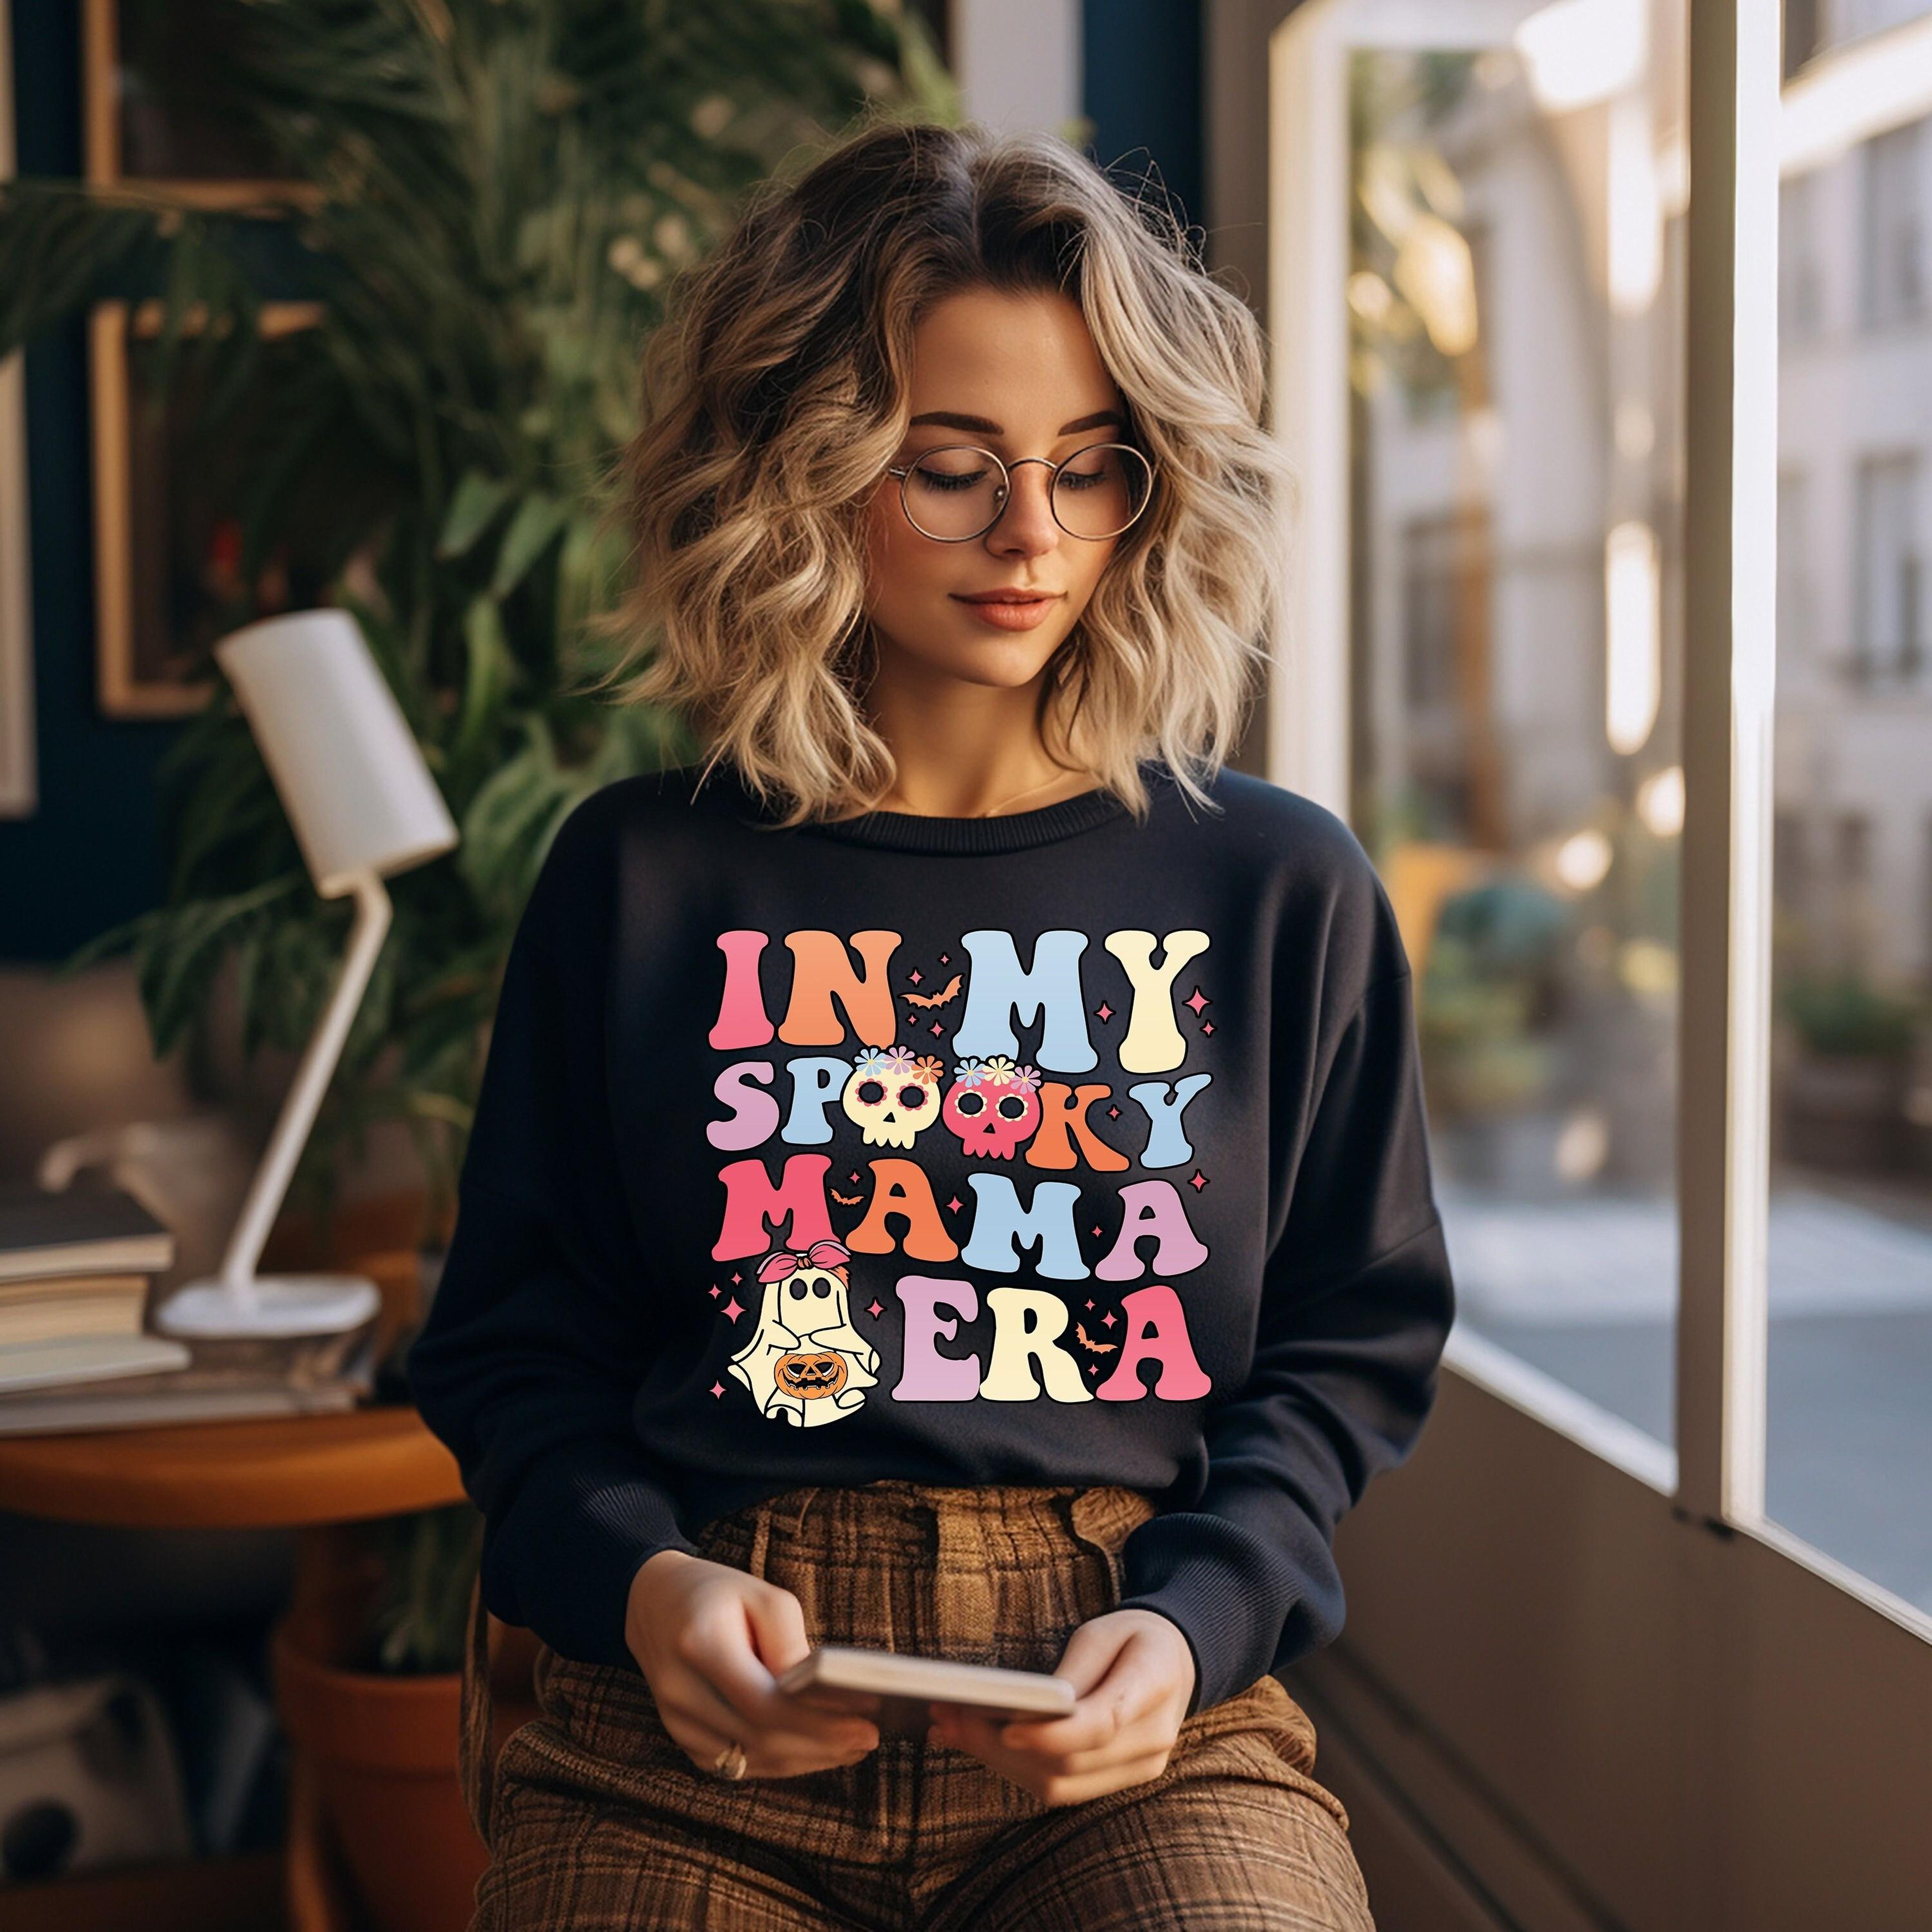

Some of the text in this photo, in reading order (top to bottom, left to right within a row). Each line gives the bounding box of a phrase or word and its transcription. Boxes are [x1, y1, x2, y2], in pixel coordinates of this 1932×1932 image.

[708, 929, 1211, 1075] IN MY
[710, 1153, 1210, 1281] MAMA
[891, 1274, 1212, 1404] ERA
